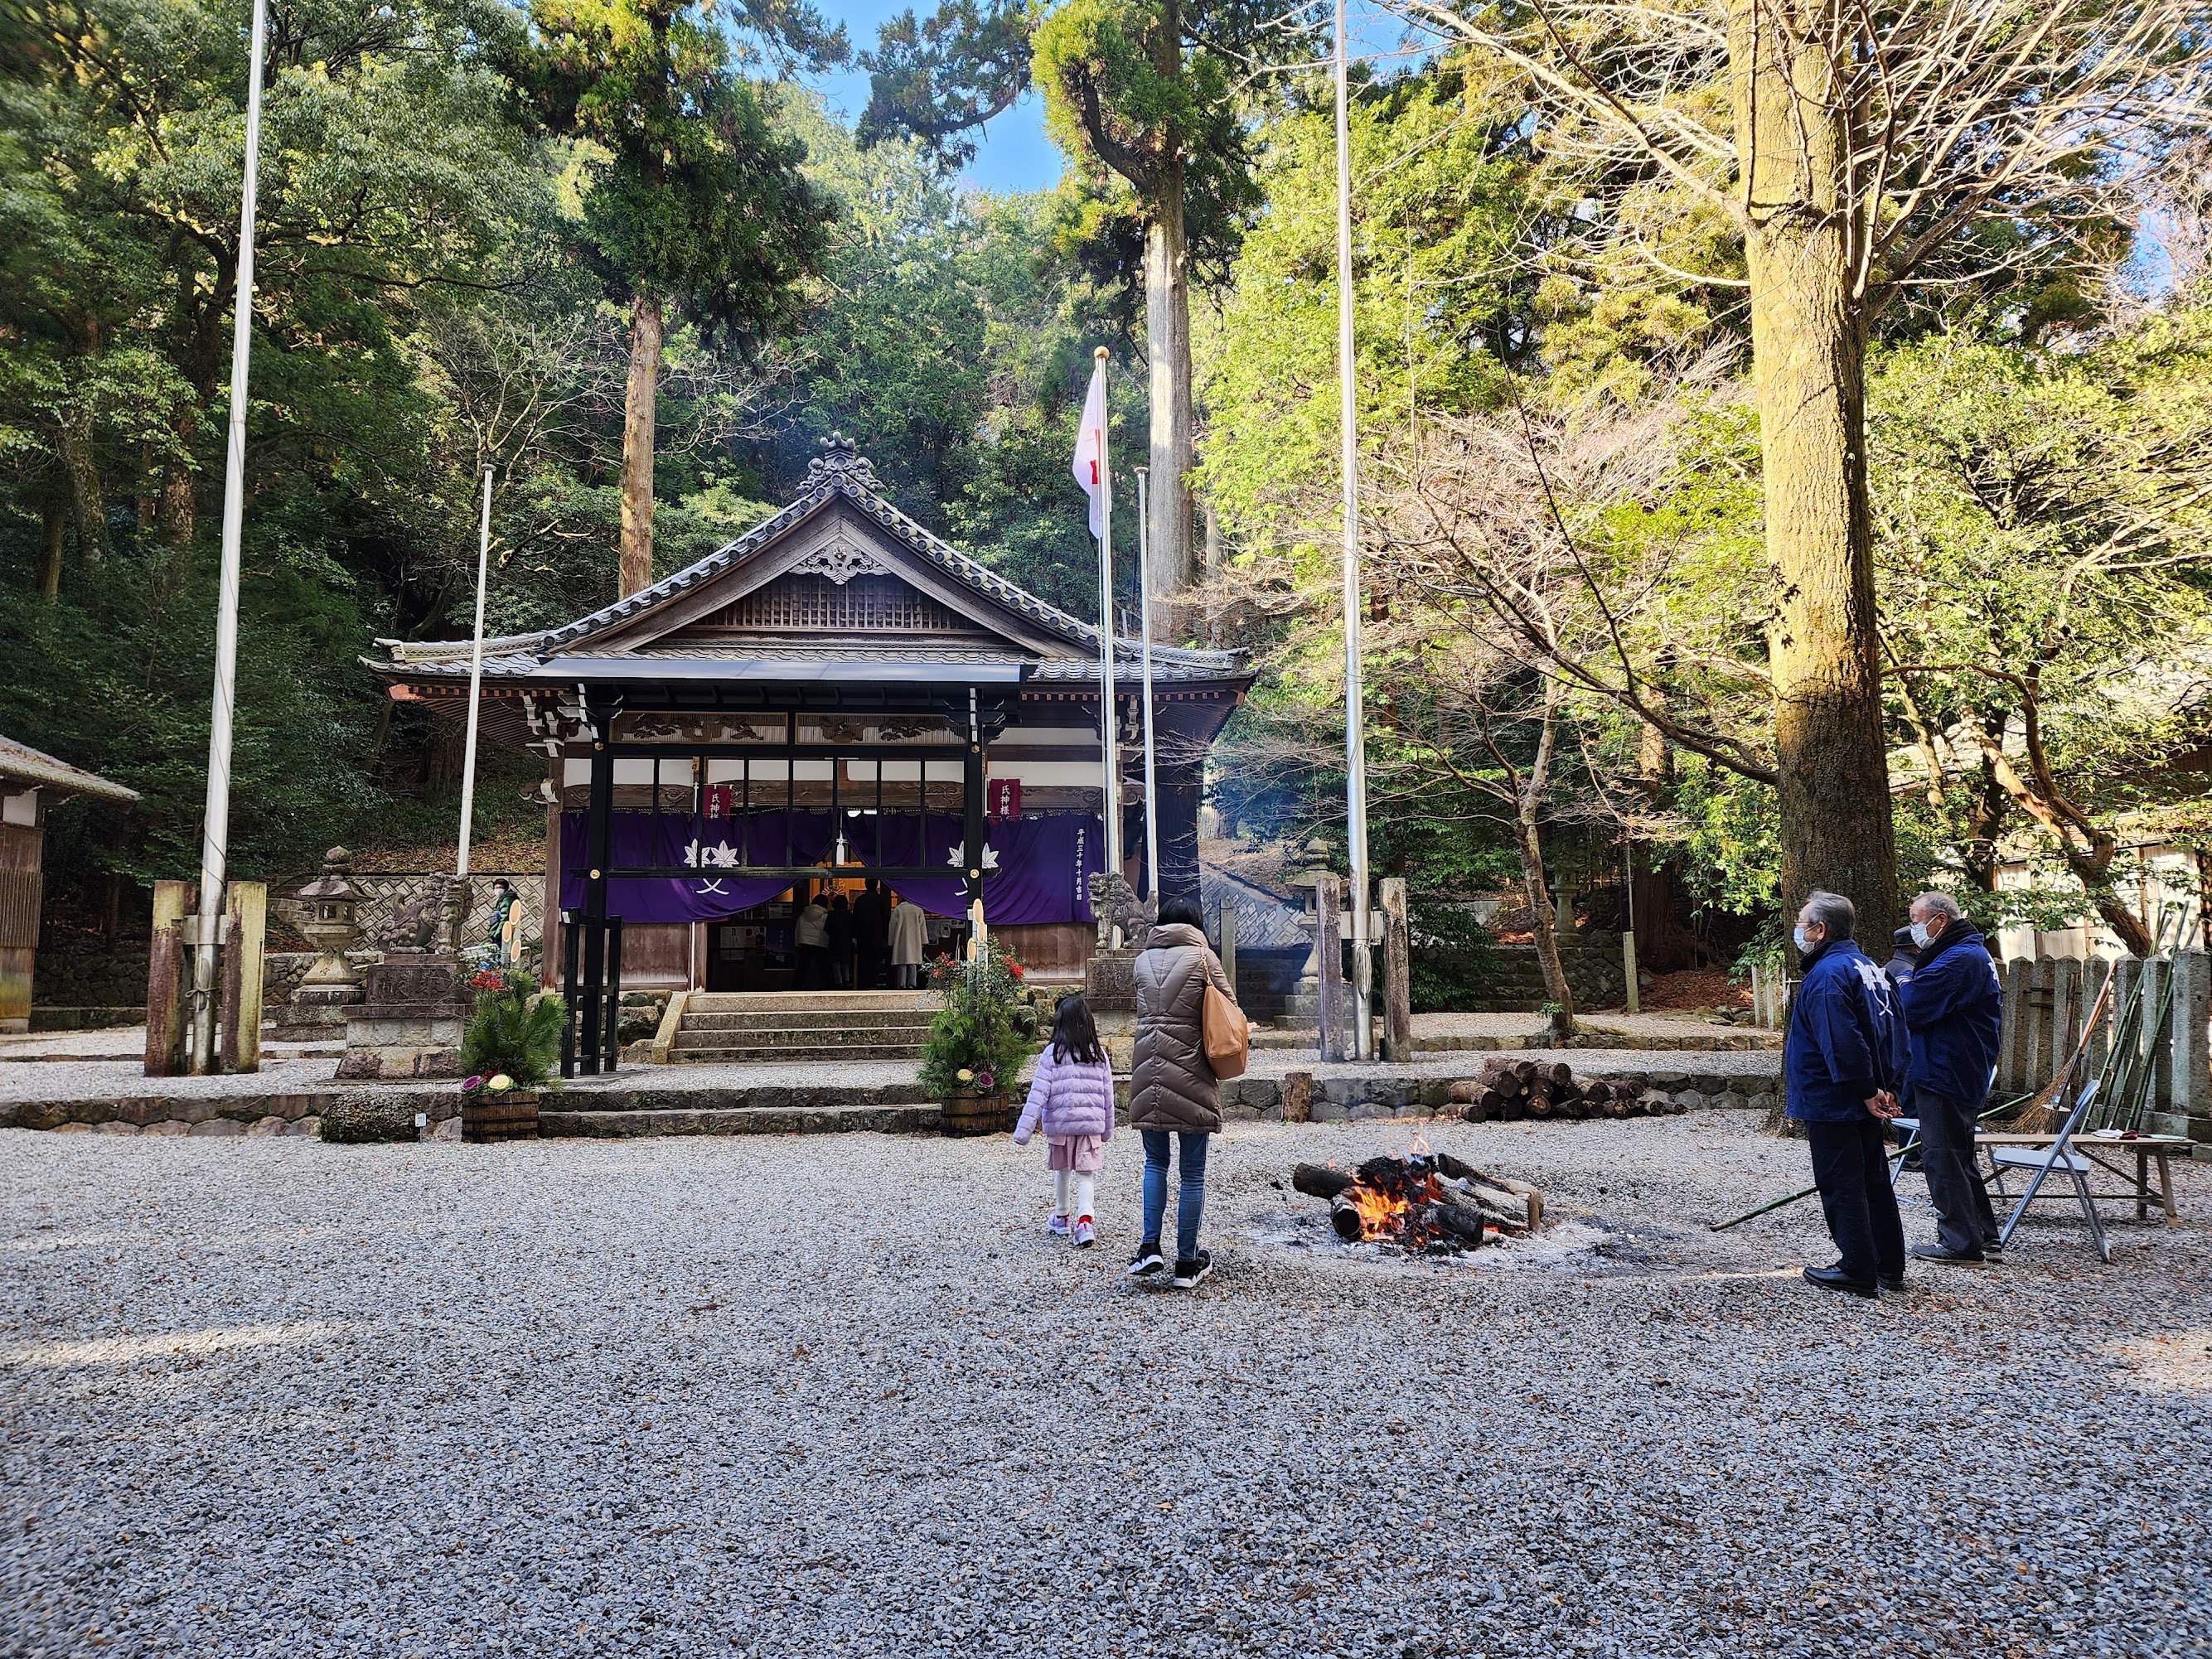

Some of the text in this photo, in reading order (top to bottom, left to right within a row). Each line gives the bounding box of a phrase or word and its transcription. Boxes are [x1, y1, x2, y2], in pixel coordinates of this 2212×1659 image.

[1000, 784, 1010, 815] 氏神様
[1075, 828, 1085, 901] 平成三十年十月吉日
